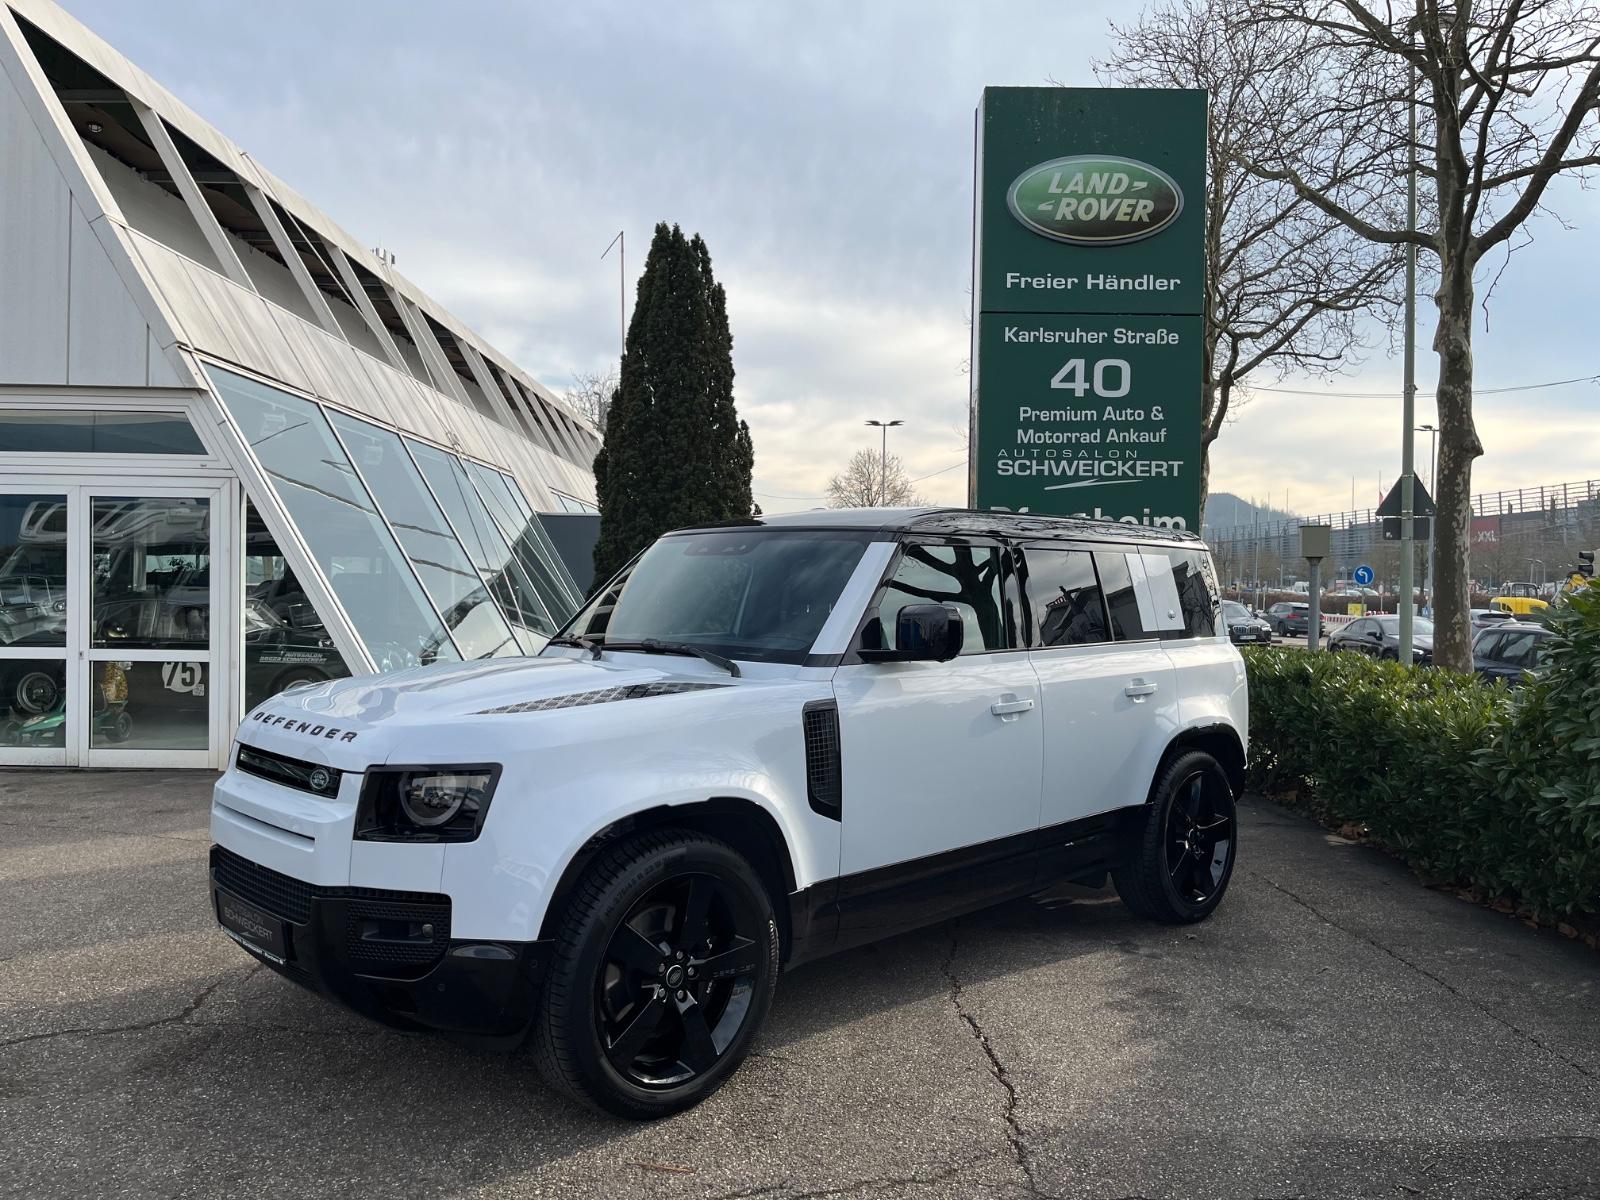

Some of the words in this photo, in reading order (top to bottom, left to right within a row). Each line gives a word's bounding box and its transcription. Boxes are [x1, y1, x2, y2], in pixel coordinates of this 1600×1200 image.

[1048, 173, 1129, 194] LAND
[1055, 199, 1155, 222] ROVER
[1006, 273, 1079, 289] Freier
[1087, 274, 1181, 291] Händler
[1004, 327, 1107, 343] Karlsruher
[1113, 328, 1179, 344] Straße
[1050, 358, 1131, 398] 40
[1019, 406, 1097, 421] Premium
[1102, 406, 1145, 421] Auto
[1151, 406, 1164, 421] &
[1017, 429, 1100, 444] Motorrad
[1106, 428, 1167, 443] Ankauf
[998, 449, 1137, 458] AUTOSALON
[997, 460, 1184, 477] SCHWEICKERT
[166, 662, 196, 687] 75
[253, 711, 358, 743] DEFENDER
